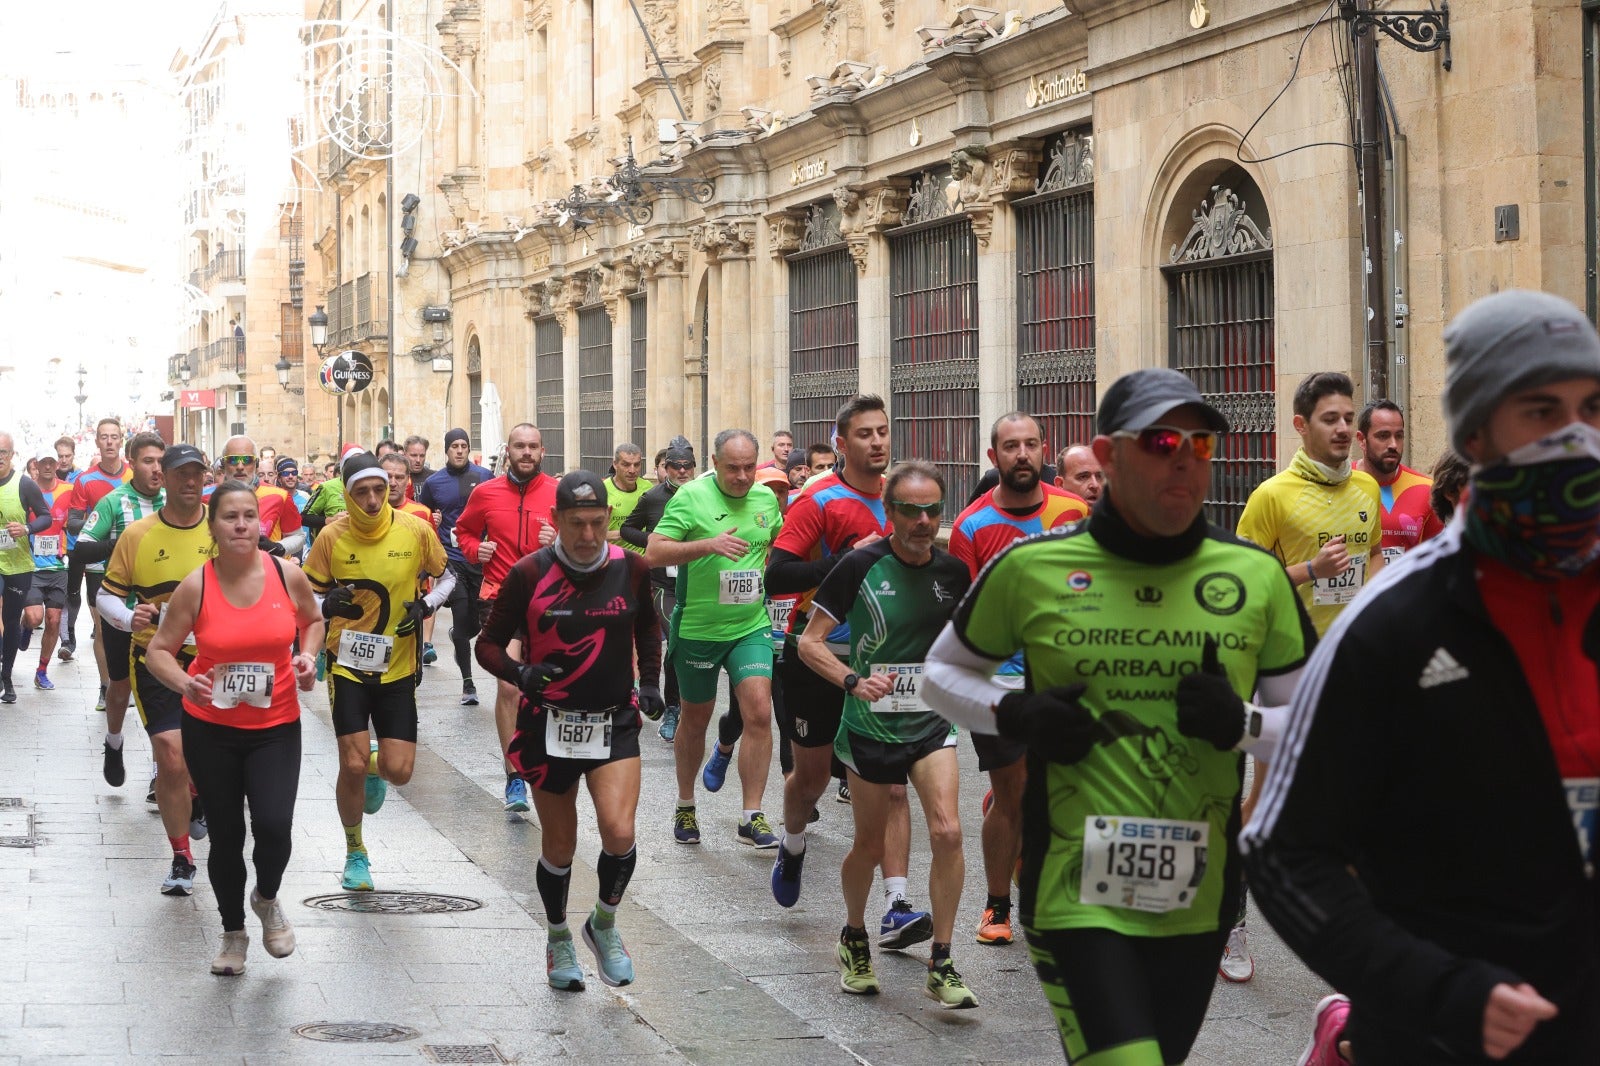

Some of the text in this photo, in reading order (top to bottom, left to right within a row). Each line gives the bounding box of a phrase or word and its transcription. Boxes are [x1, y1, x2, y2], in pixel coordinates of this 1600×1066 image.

[1499, 207, 1508, 238] 4
[334, 369, 371, 380] GUINNESS
[1355, 532, 1368, 543] GO
[733, 571, 759, 579] SETEL
[728, 578, 753, 593] 1768
[355, 633, 389, 645] SETEL
[350, 641, 376, 659] 456
[228, 664, 268, 673] SETEL
[223, 674, 256, 693] 1479
[887, 676, 917, 696] 44
[558, 723, 594, 743] 1587
[1122, 823, 1196, 841] SETEL
[1106, 842, 1176, 881] 1358
